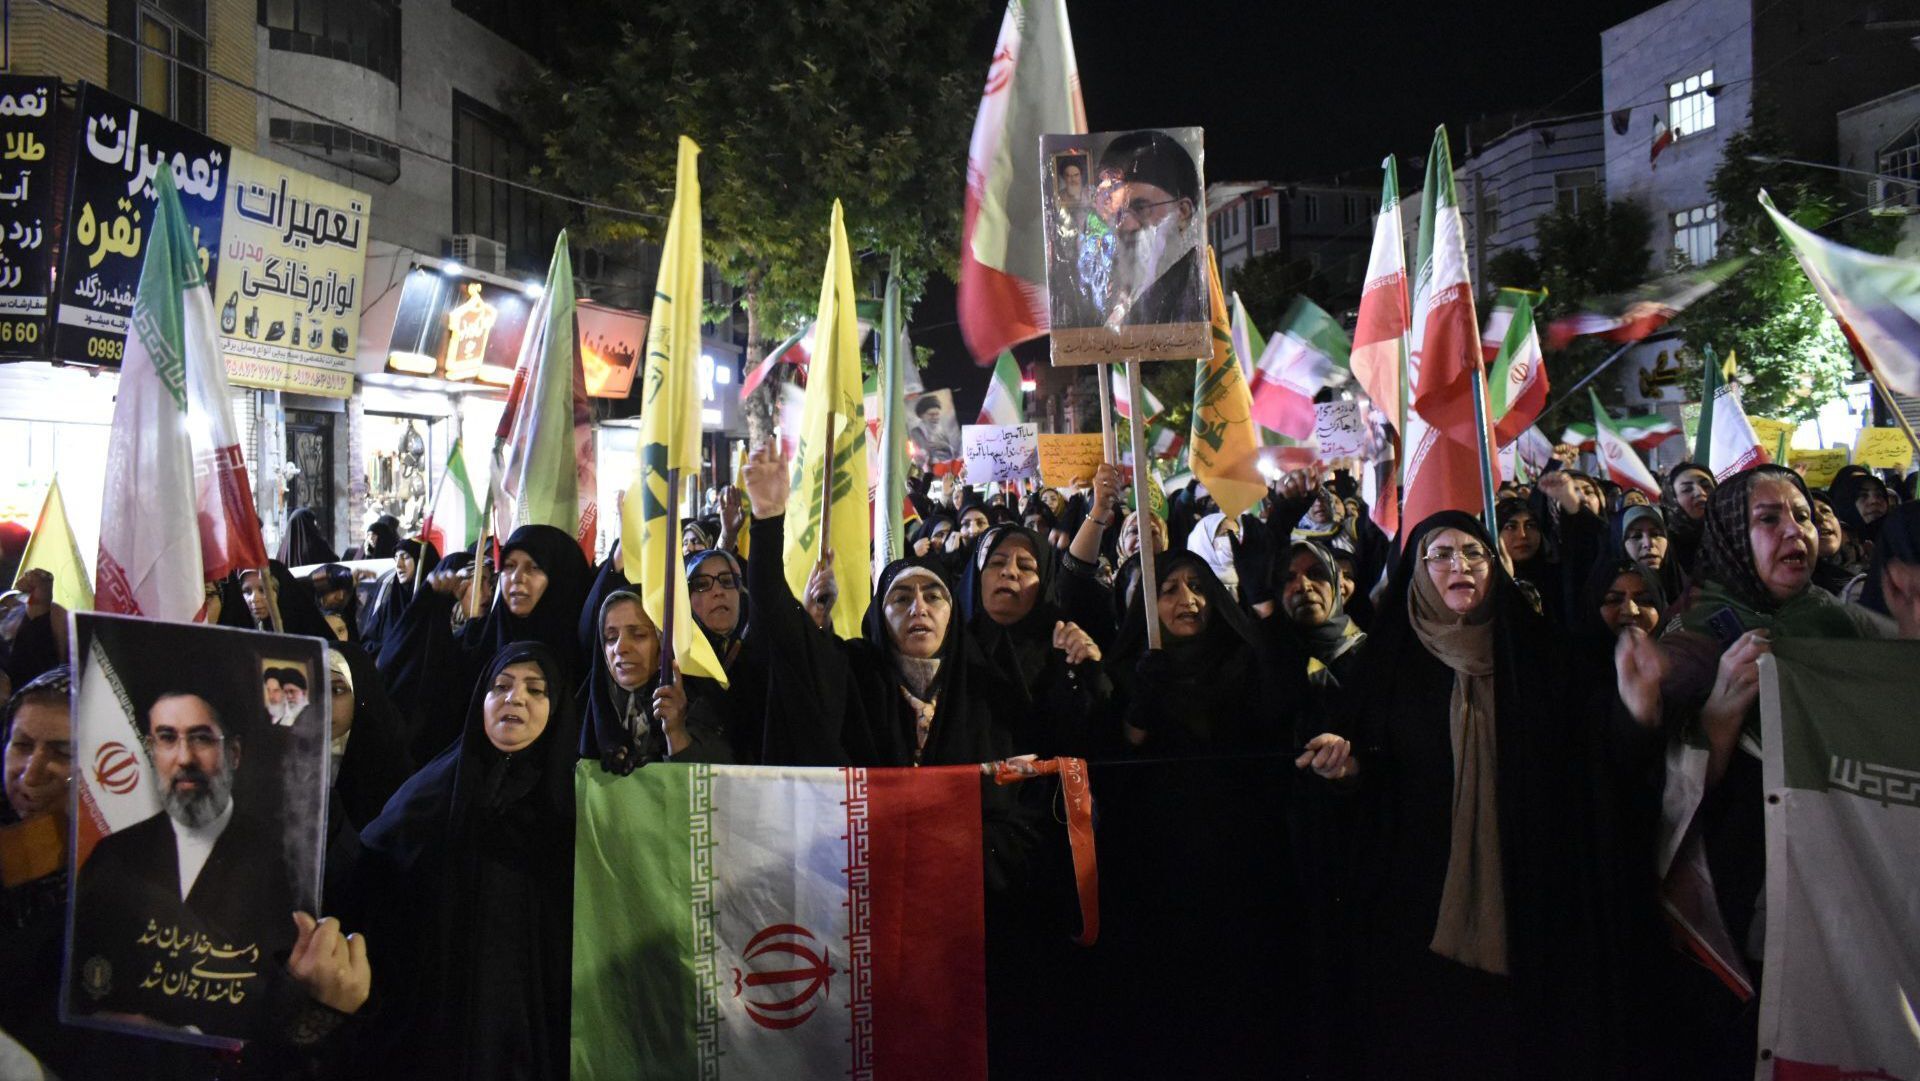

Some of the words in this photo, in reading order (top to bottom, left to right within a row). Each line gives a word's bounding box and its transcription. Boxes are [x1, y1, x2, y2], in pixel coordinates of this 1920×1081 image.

[5, 132, 46, 161] طلا
[87, 109, 222, 201] تعمیرات
[0, 169, 32, 208] آب
[236, 179, 362, 250] تعمیرات
[9, 218, 43, 250] زرد
[77, 197, 142, 269] نقره
[229, 234, 264, 263] مدرن
[242, 256, 310, 299] خانگی
[308, 270, 356, 316] لوازم
[15, 322, 38, 343] 60
[88, 337, 124, 360] 0993
[136, 918, 159, 945] شد
[157, 925, 192, 959] عیان
[190, 930, 211, 955] خدا
[209, 942, 260, 964] دست
[139, 960, 163, 989] شد
[162, 970, 201, 1001] جوان
